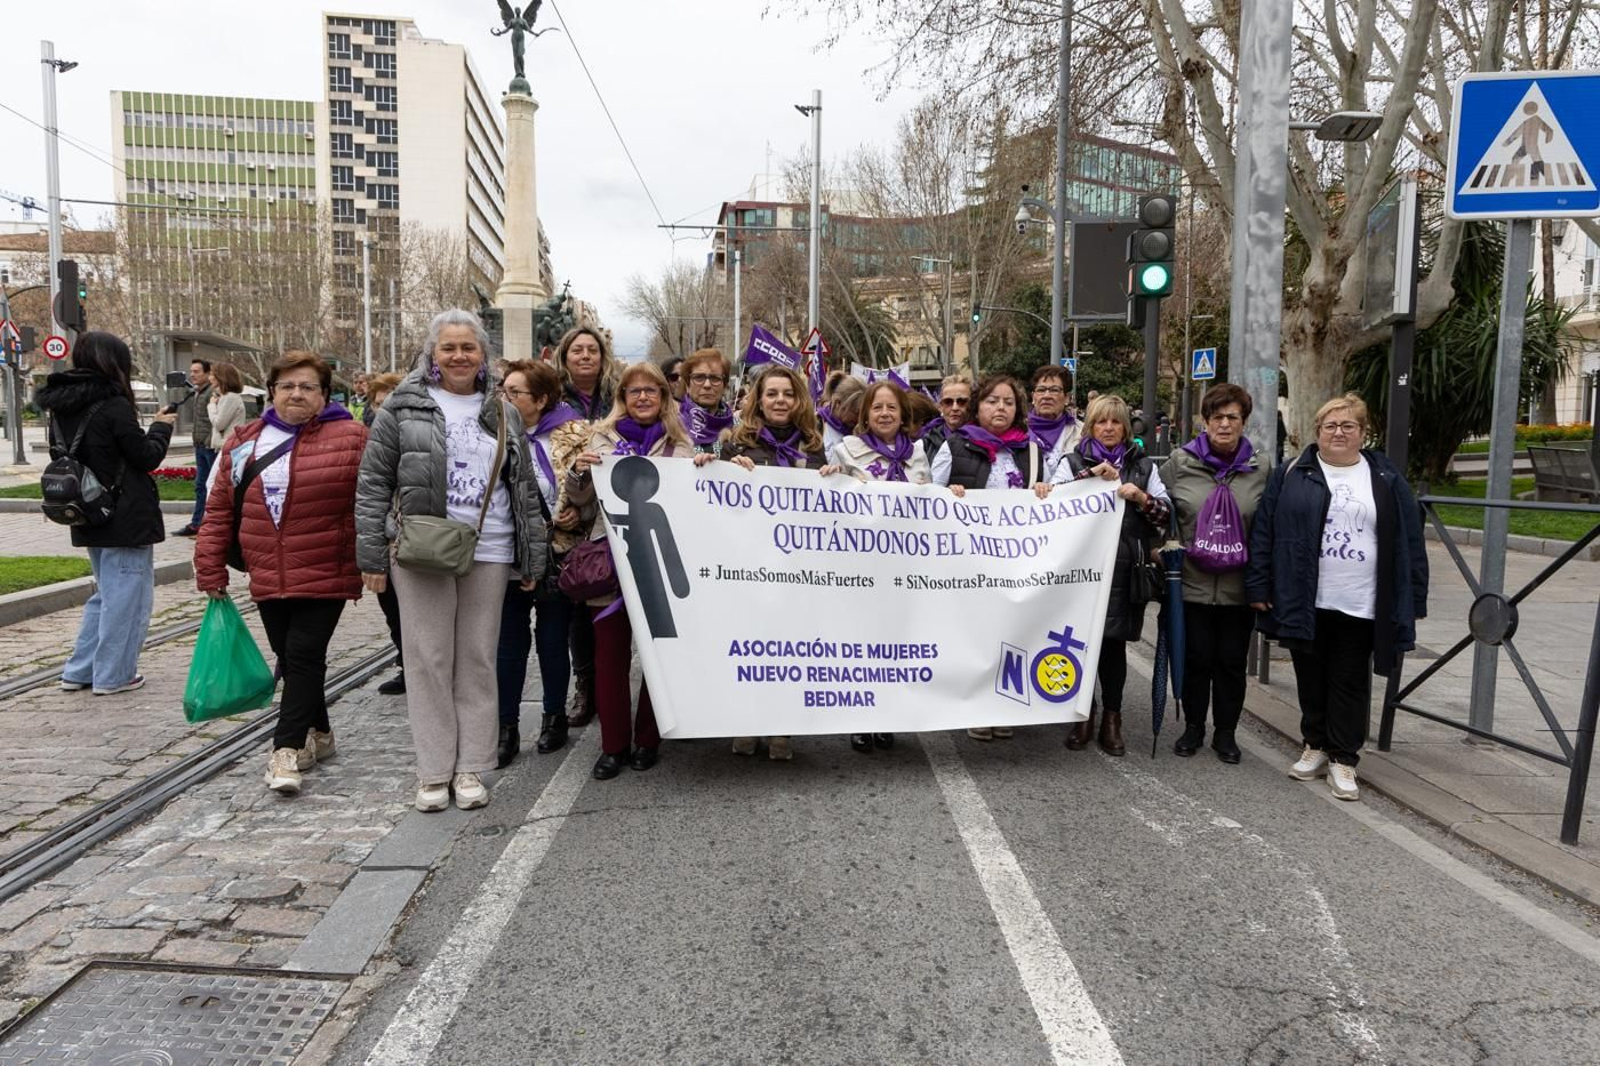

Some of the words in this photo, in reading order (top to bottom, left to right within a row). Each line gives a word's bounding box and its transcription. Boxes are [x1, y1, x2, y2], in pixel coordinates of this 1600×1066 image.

[48, 343, 63, 352] 30
[758, 484, 873, 516] QUITARON
[877, 494, 948, 520] TANTO
[952, 502, 992, 527] QUE
[998, 489, 1117, 527] ACABARON
[773, 520, 930, 556] QUITÁNDONOS
[935, 532, 964, 556] EL
[715, 564, 875, 588] JuntasSomosMásFuertes
[906, 567, 1103, 591] SiNosotrasParamosSeParaElMu
[728, 638, 838, 659] ASOCIACIÓN
[841, 643, 864, 659] DE
[867, 643, 939, 661] MUJERES
[737, 665, 802, 682] NUEVO
[806, 666, 933, 683] RENACIMIENTO
[804, 690, 876, 707] BEDMAR
